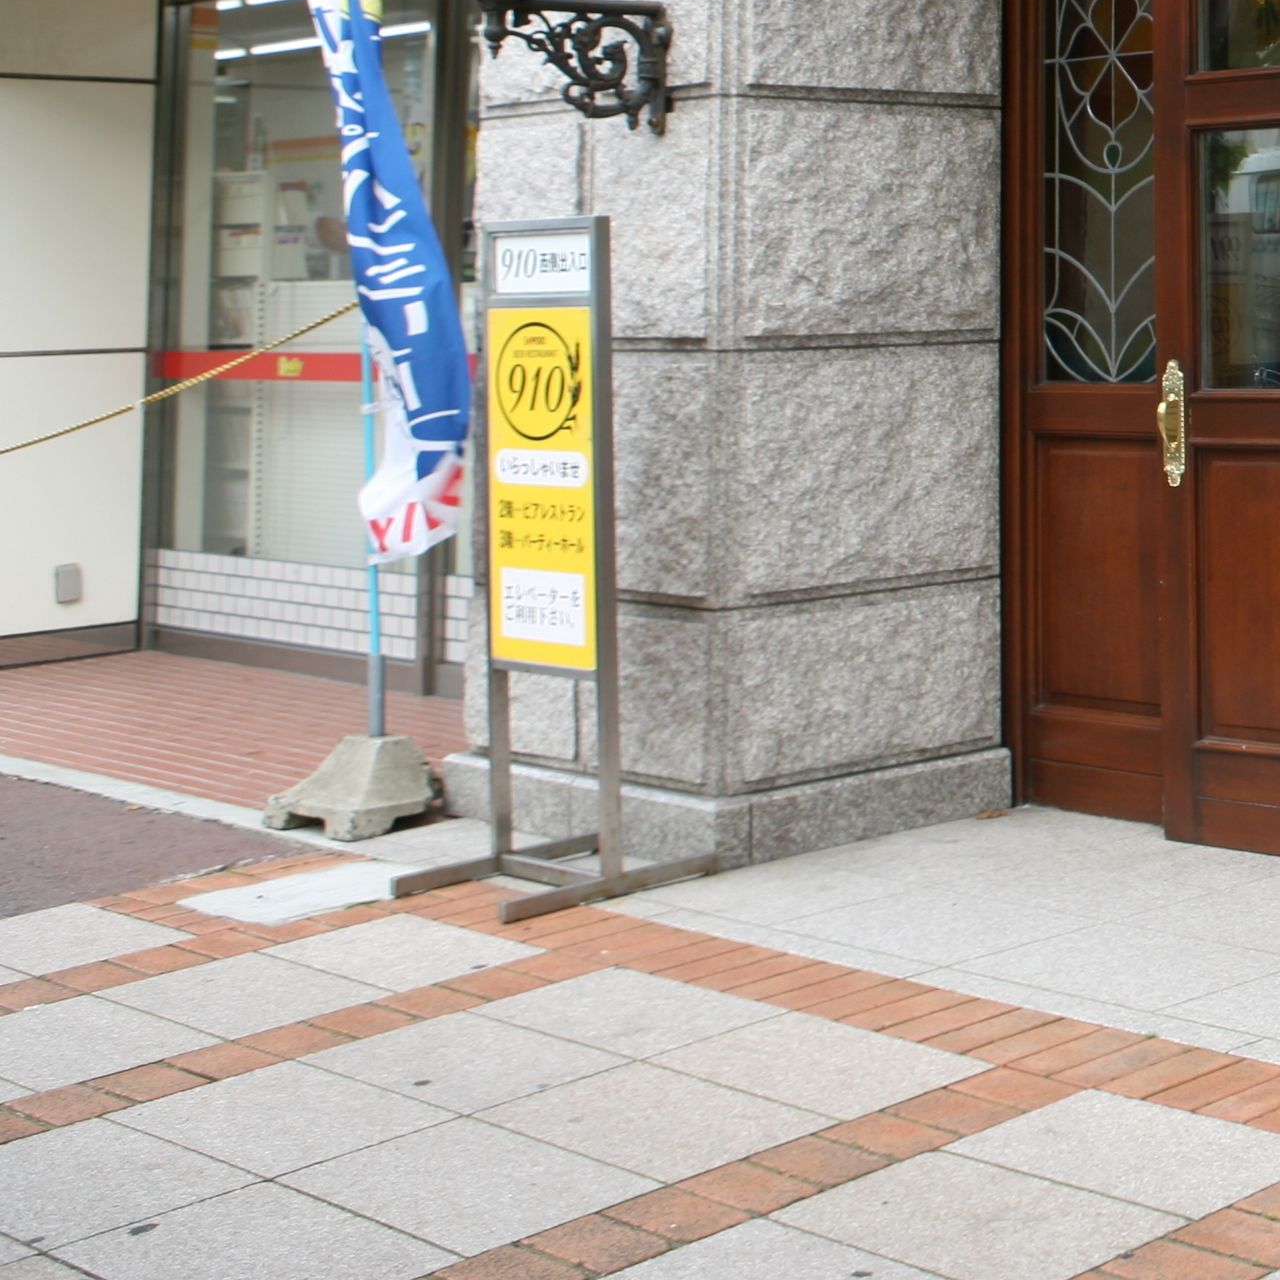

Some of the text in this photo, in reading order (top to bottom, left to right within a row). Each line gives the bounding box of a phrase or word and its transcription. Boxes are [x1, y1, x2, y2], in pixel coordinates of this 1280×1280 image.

[509, 363, 566, 414] 910
[504, 584, 581, 608] エレベーターを
